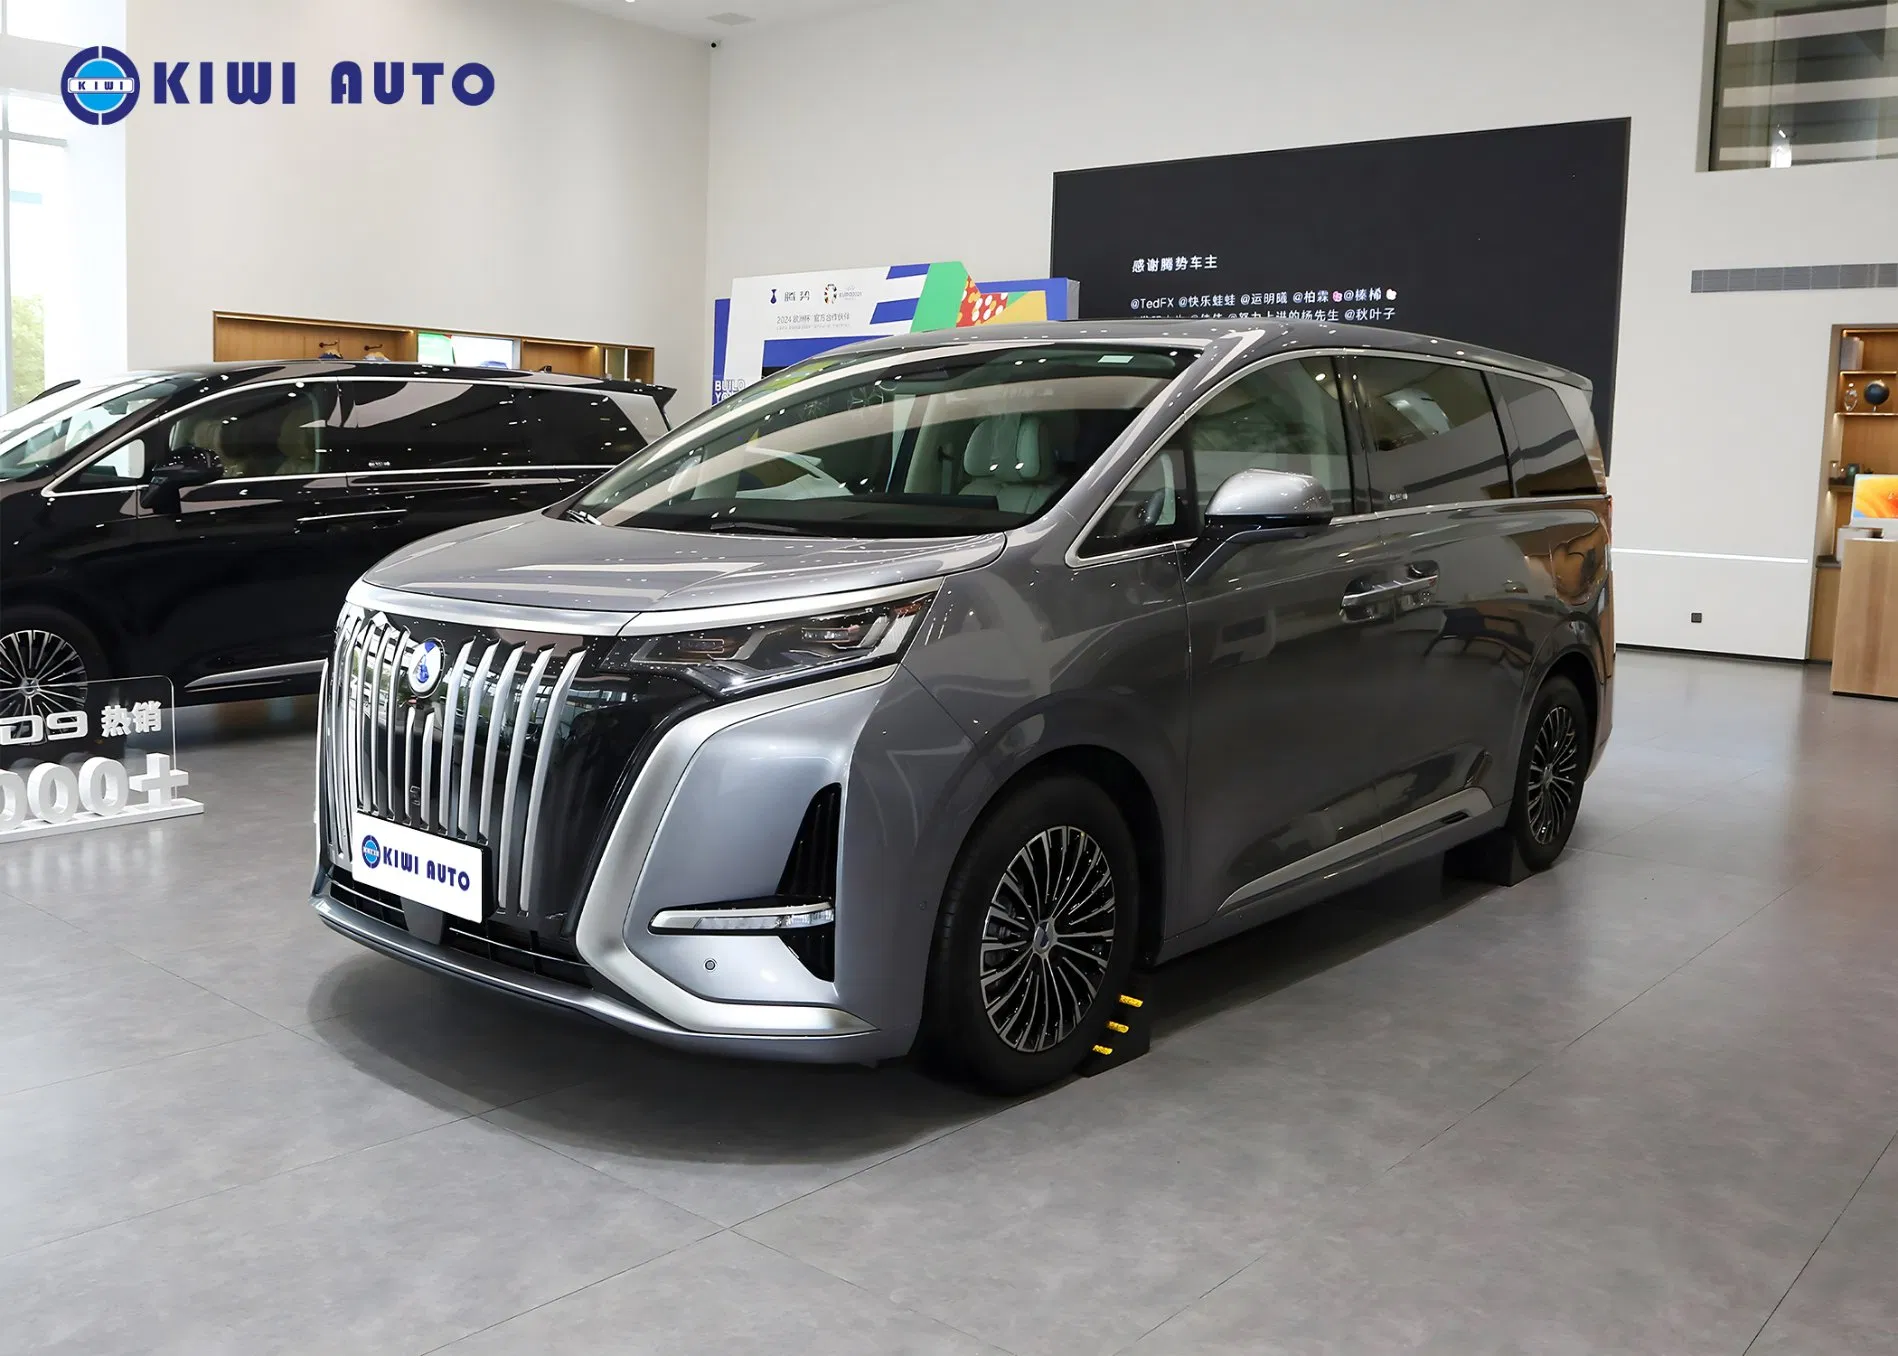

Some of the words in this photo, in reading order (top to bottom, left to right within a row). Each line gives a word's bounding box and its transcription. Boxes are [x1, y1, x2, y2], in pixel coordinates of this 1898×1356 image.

[1131, 254, 1218, 273] 感谢腾势车主
[1130, 297, 1175, 310] @TedFX
[1178, 293, 1236, 308] @快乐蛙蛙
[1344, 307, 1396, 321] @秋叶子
[715, 380, 745, 391] BUILD
[101, 700, 162, 738] 热销
[383, 845, 419, 875] KIWI
[426, 860, 470, 892] AUTO
